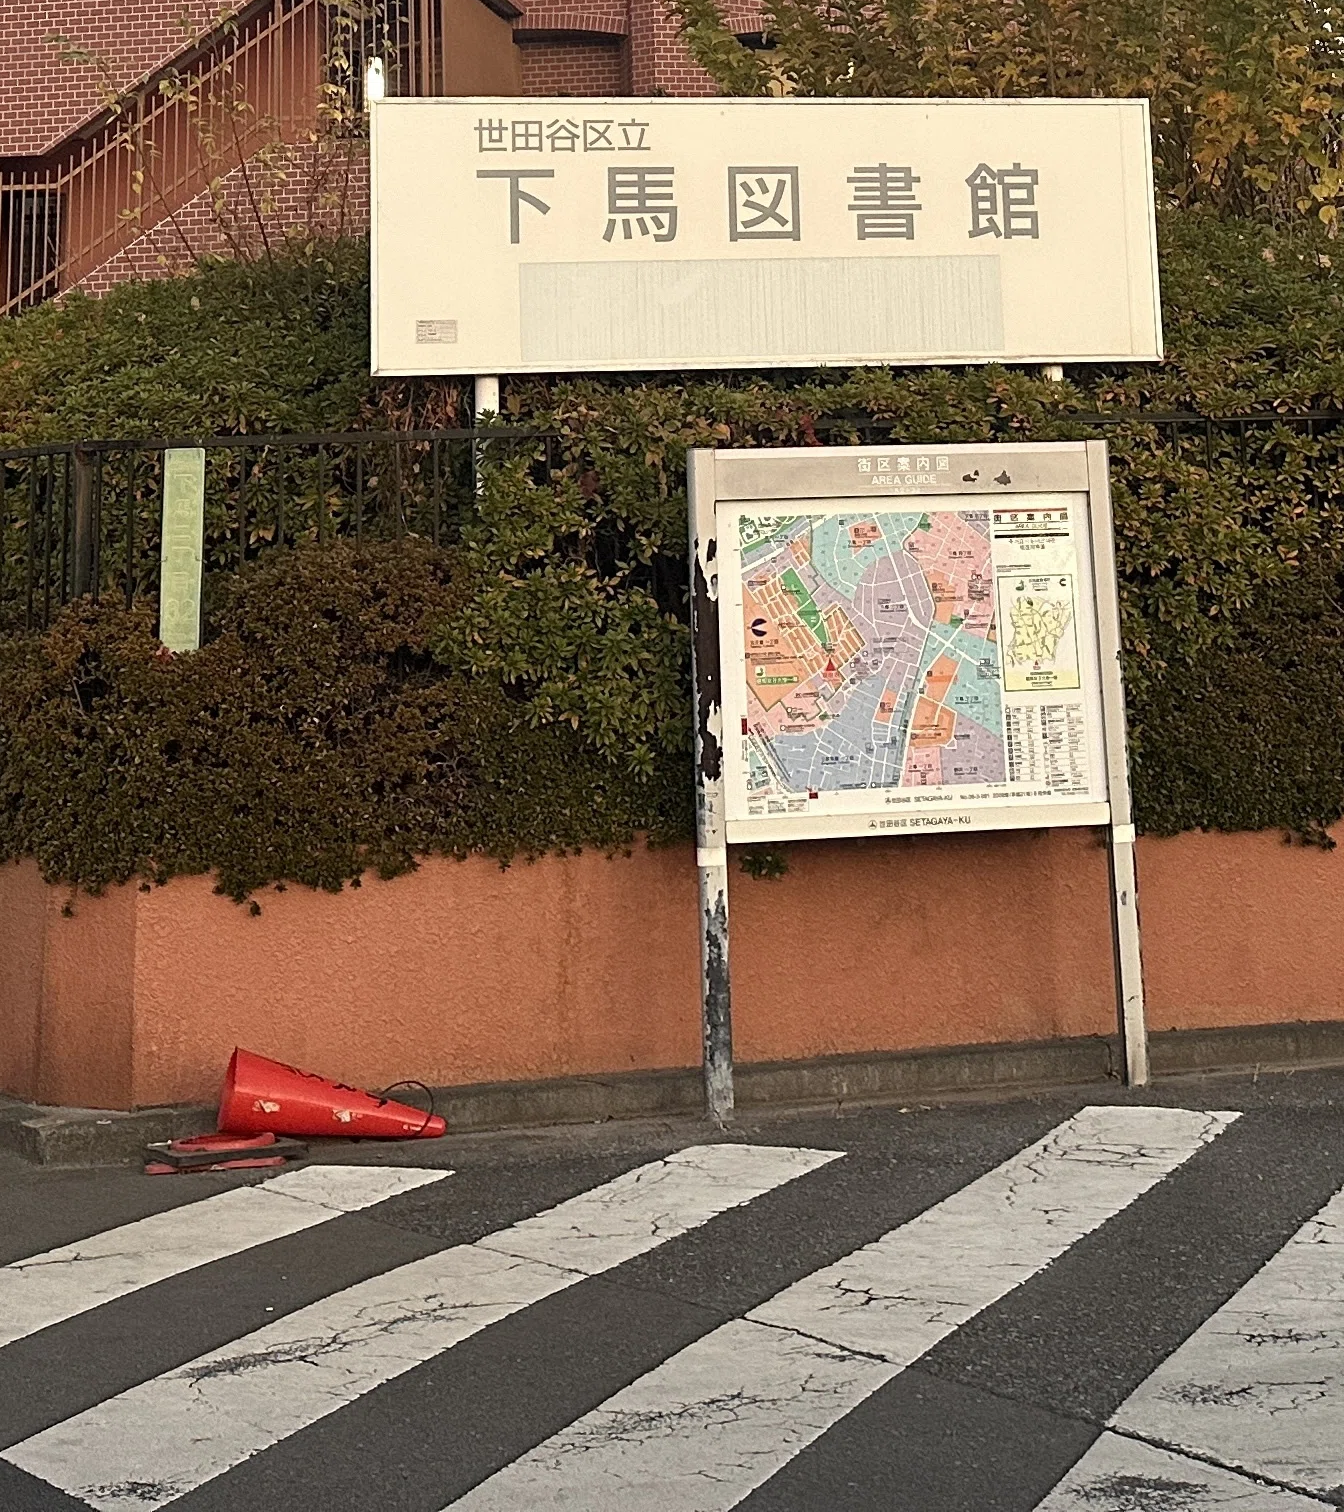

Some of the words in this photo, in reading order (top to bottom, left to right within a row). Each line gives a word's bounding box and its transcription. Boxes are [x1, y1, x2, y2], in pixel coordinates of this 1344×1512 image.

[474, 118, 651, 153] 世田谷区立
[476, 163, 1041, 245] 下馬図書館
[857, 456, 950, 472] 街区案内図
[871, 474, 902, 485] AREA
[904, 473, 937, 484] GUIDE
[909, 815, 972, 827] SETAGAYA-KU
